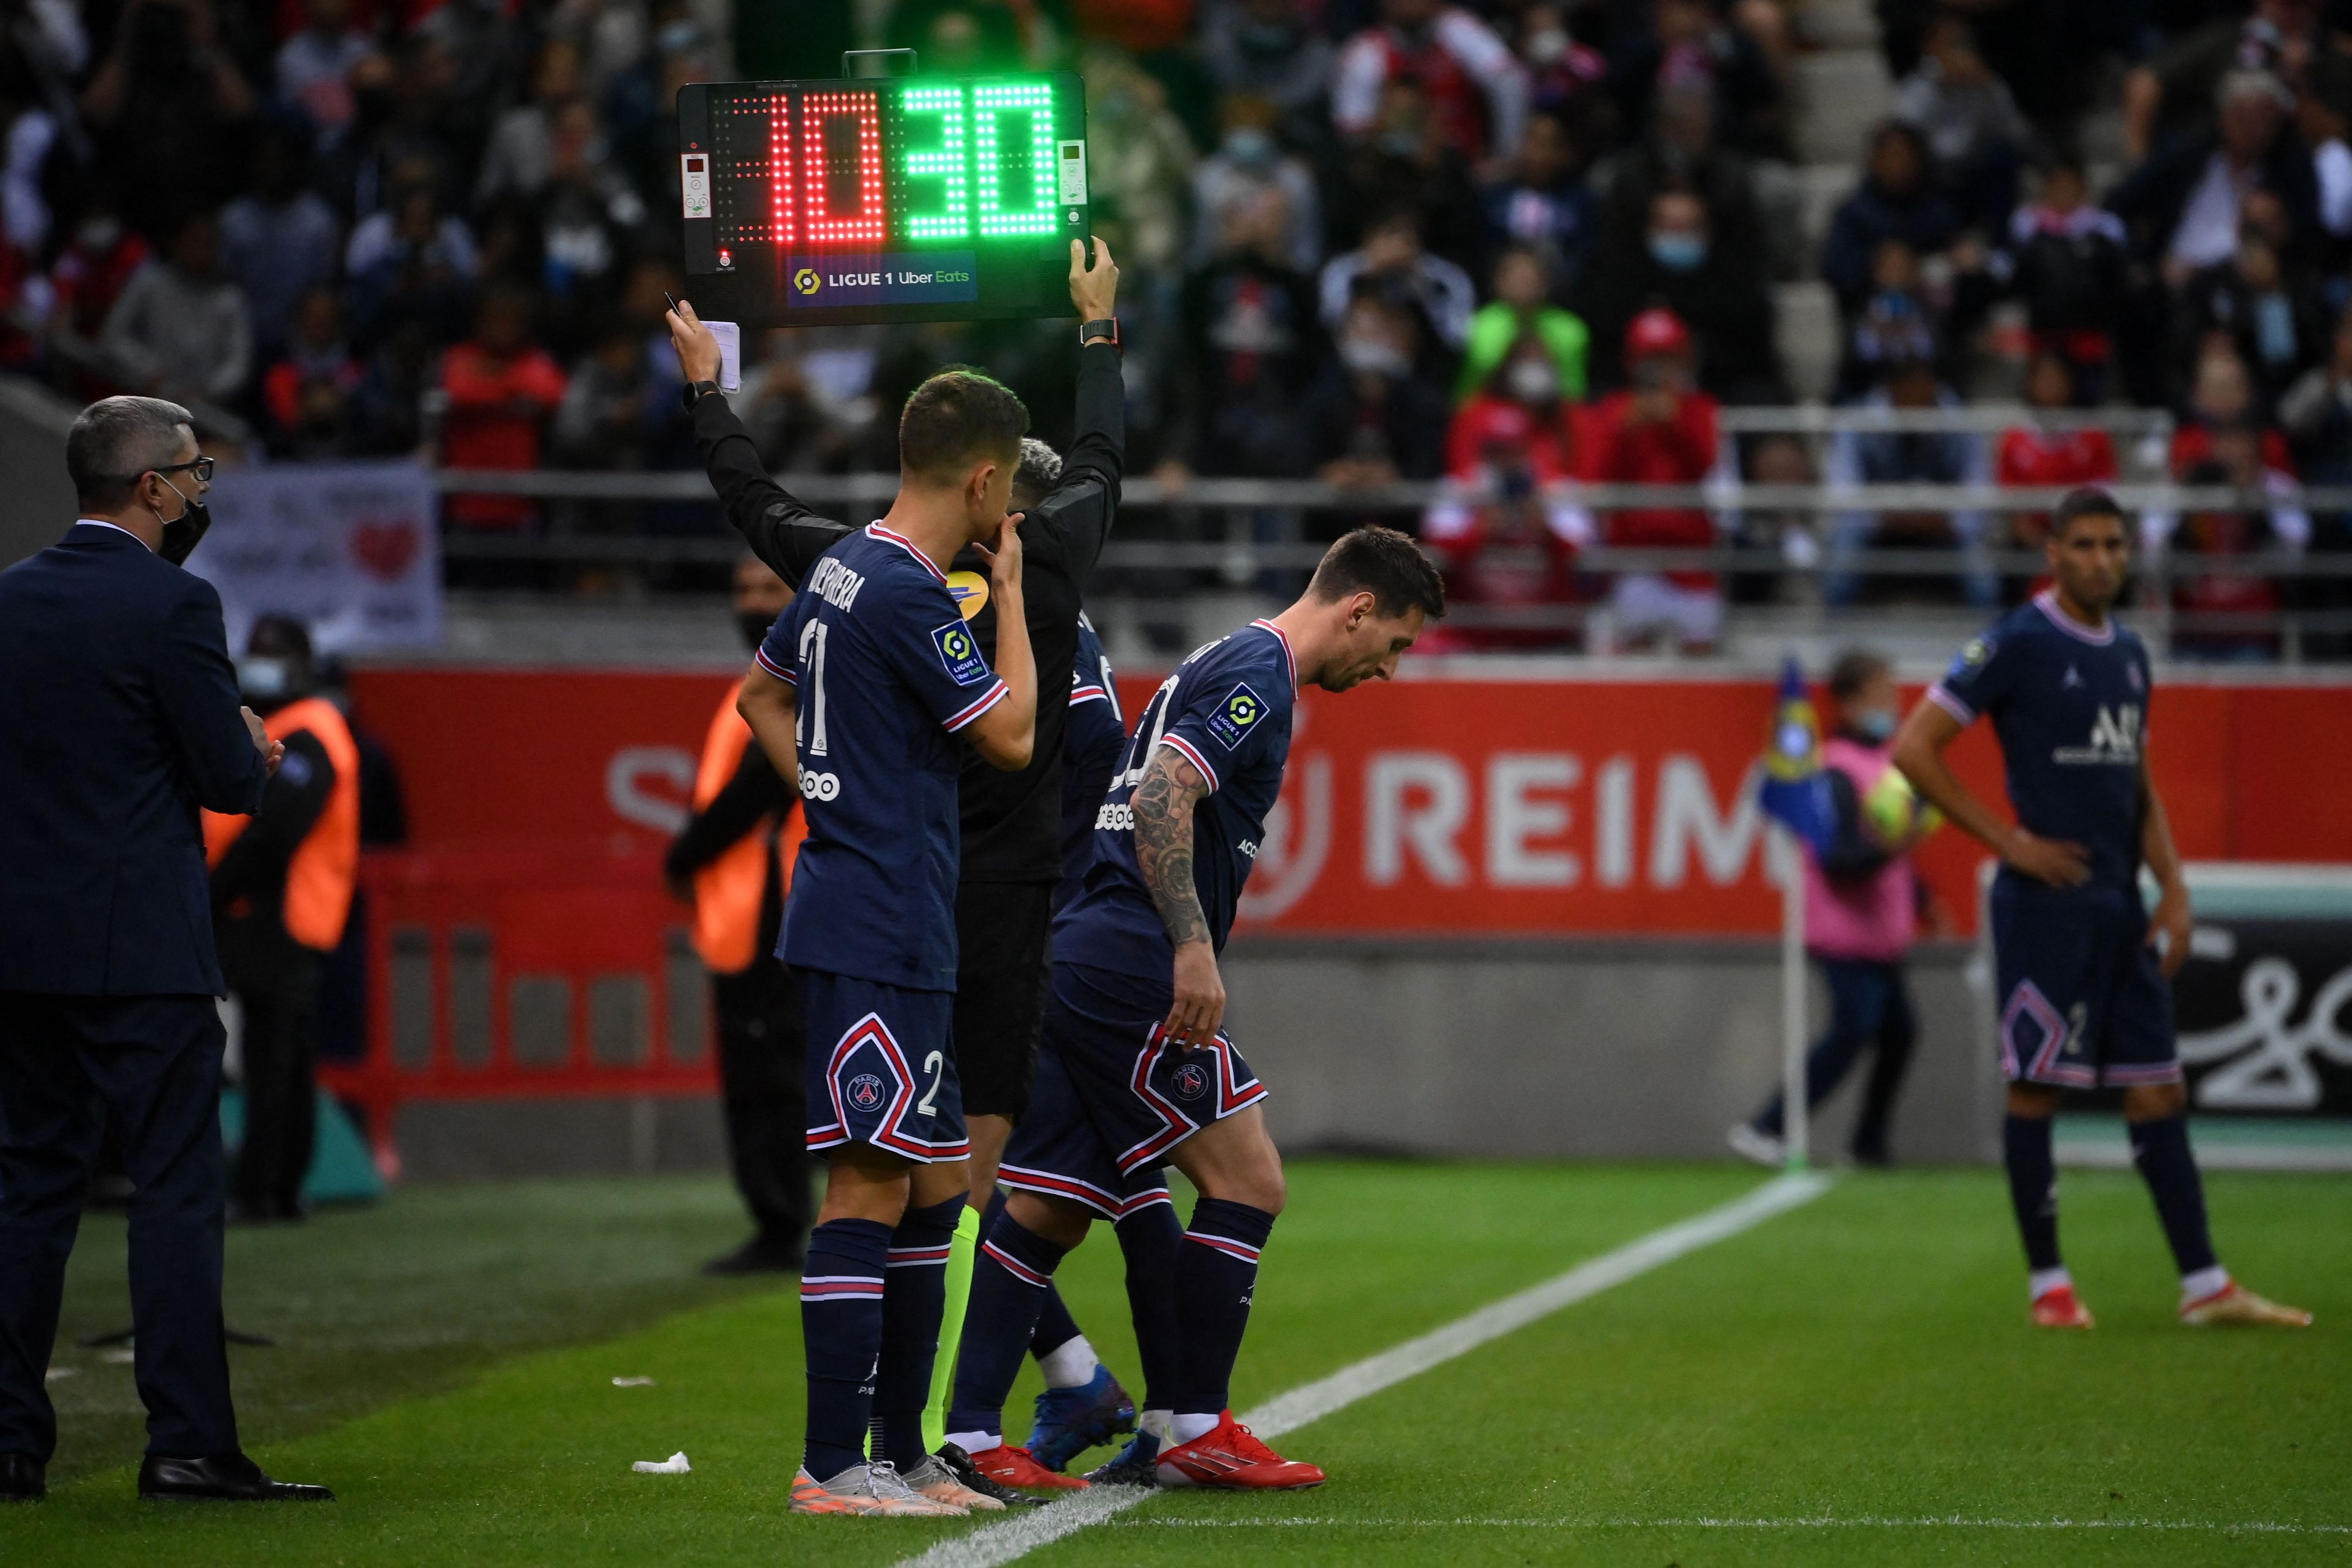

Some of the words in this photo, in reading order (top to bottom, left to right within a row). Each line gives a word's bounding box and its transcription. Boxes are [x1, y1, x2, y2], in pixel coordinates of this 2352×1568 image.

[902, 84, 1058, 240] 30
[829, 273, 881, 287] LIGUE
[885, 272, 893, 285] 1
[898, 271, 933, 284] Uber
[935, 270, 970, 283] Eats
[953, 659, 975, 674] LIGUE
[1210, 718, 1224, 732] Uber
[1222, 729, 1235, 743] Eats
[1216, 714, 1237, 733] LIGUE
[1363, 752, 1788, 891] REIM
[854, 1075, 880, 1087] PARIS
[1174, 1066, 1197, 1080] PARIS
[917, 1050, 944, 1117] 2
[1239, 1296, 1252, 1306] PA
